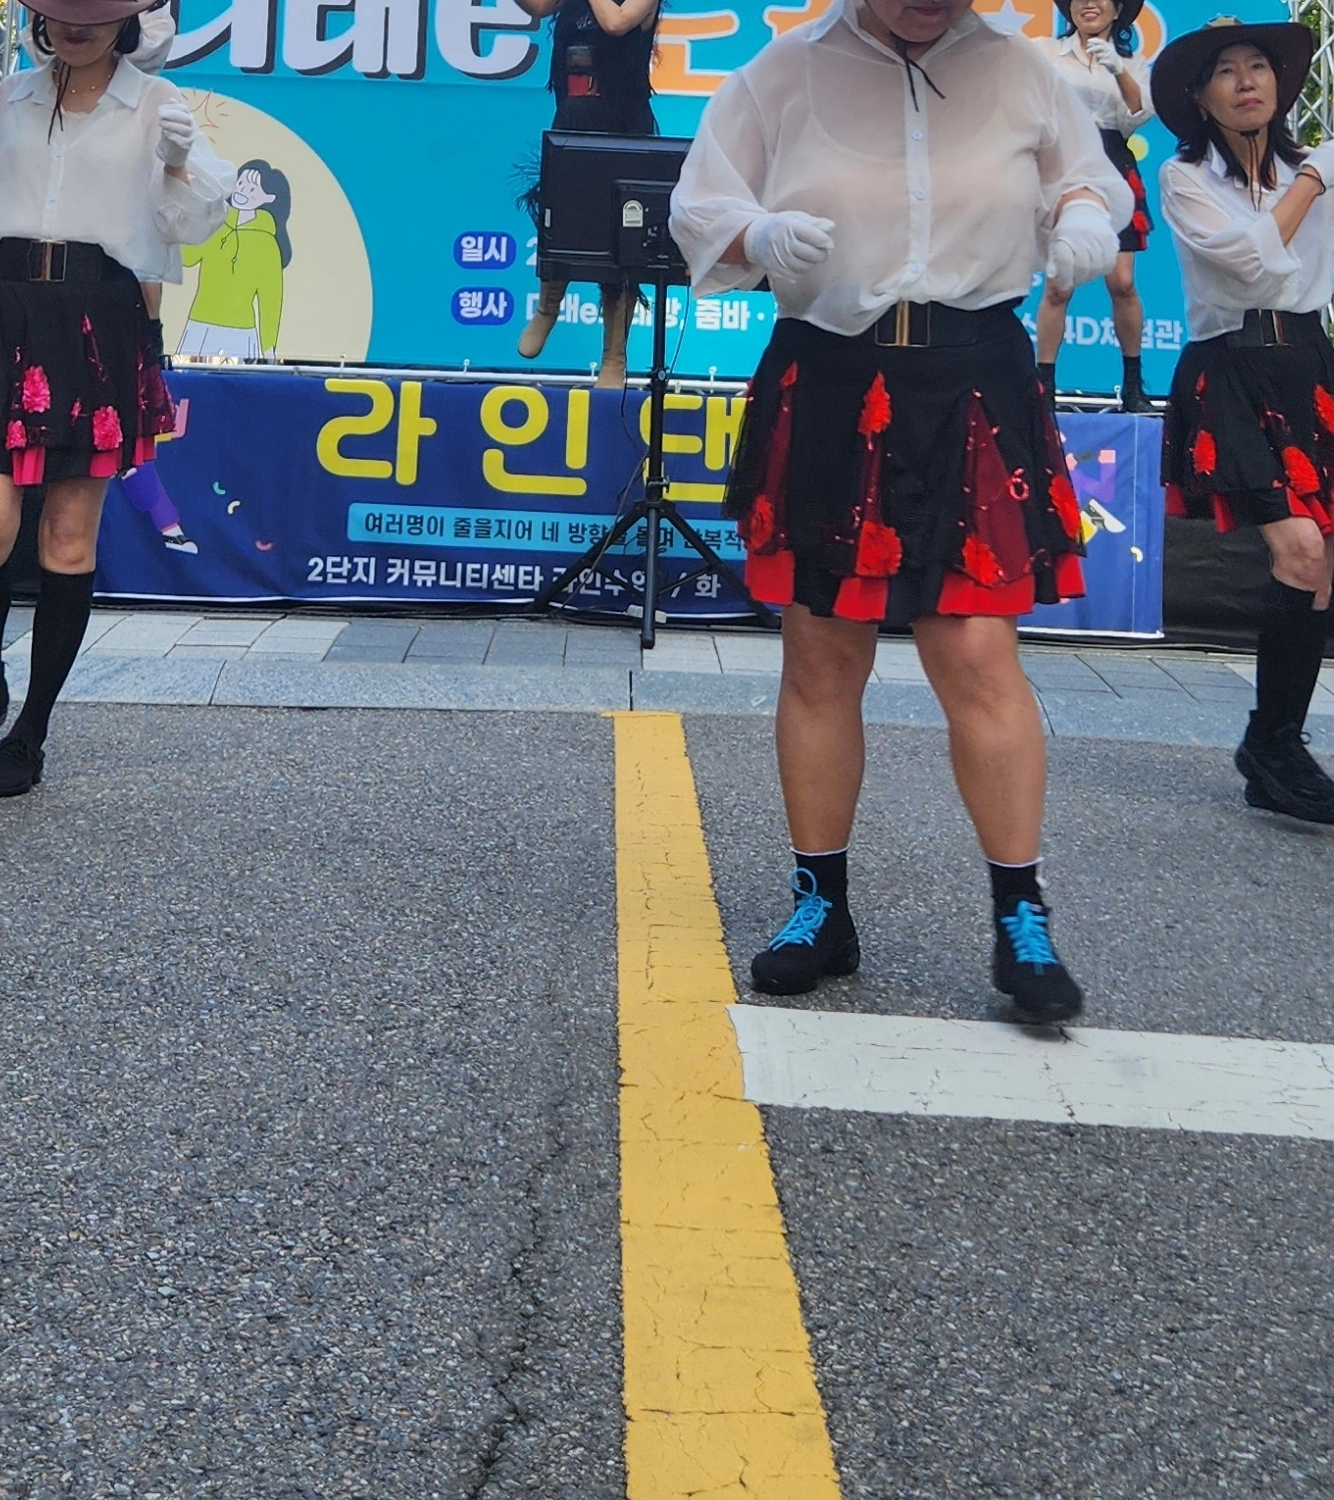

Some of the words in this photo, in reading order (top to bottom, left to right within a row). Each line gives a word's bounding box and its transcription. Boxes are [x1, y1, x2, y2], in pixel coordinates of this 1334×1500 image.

[460, 235, 507, 263] 일시
[459, 291, 507, 319] 행사
[364, 512, 445, 537] 여러명이
[452, 516, 533, 541] 줄을지어
[541, 521, 560, 543] 네
[307, 556, 377, 585] 2단지
[386, 558, 545, 592] 커뮤니티센타
